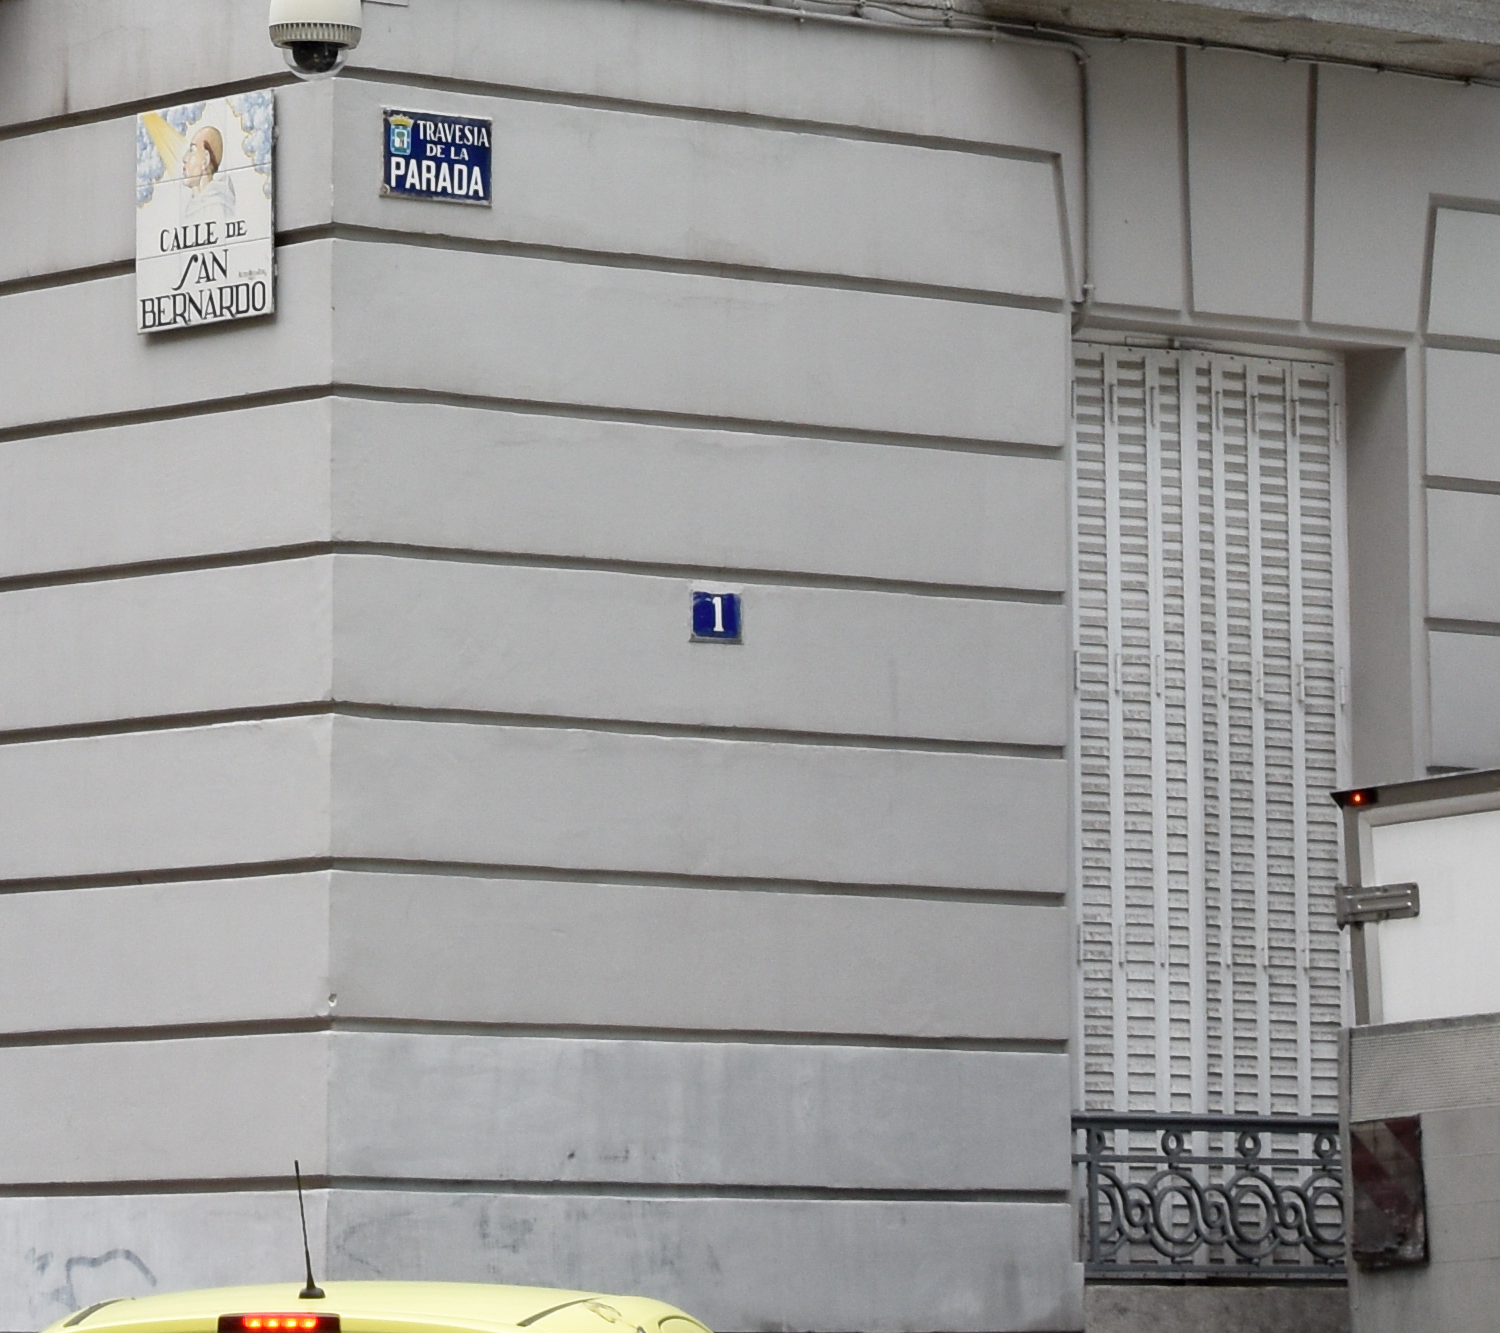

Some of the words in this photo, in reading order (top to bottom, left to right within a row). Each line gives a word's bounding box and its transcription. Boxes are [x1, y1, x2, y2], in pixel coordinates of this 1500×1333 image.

[417, 120, 490, 148] TRAVESIA
[426, 143, 446, 158] DE
[450, 146, 469, 161] LA
[390, 156, 484, 198] PARADA
[160, 221, 219, 252] CALLE
[225, 220, 247, 239] DE
[171, 248, 229, 291] SAN
[140, 280, 266, 329] BERNARDO
[712, 596, 725, 632] 1
